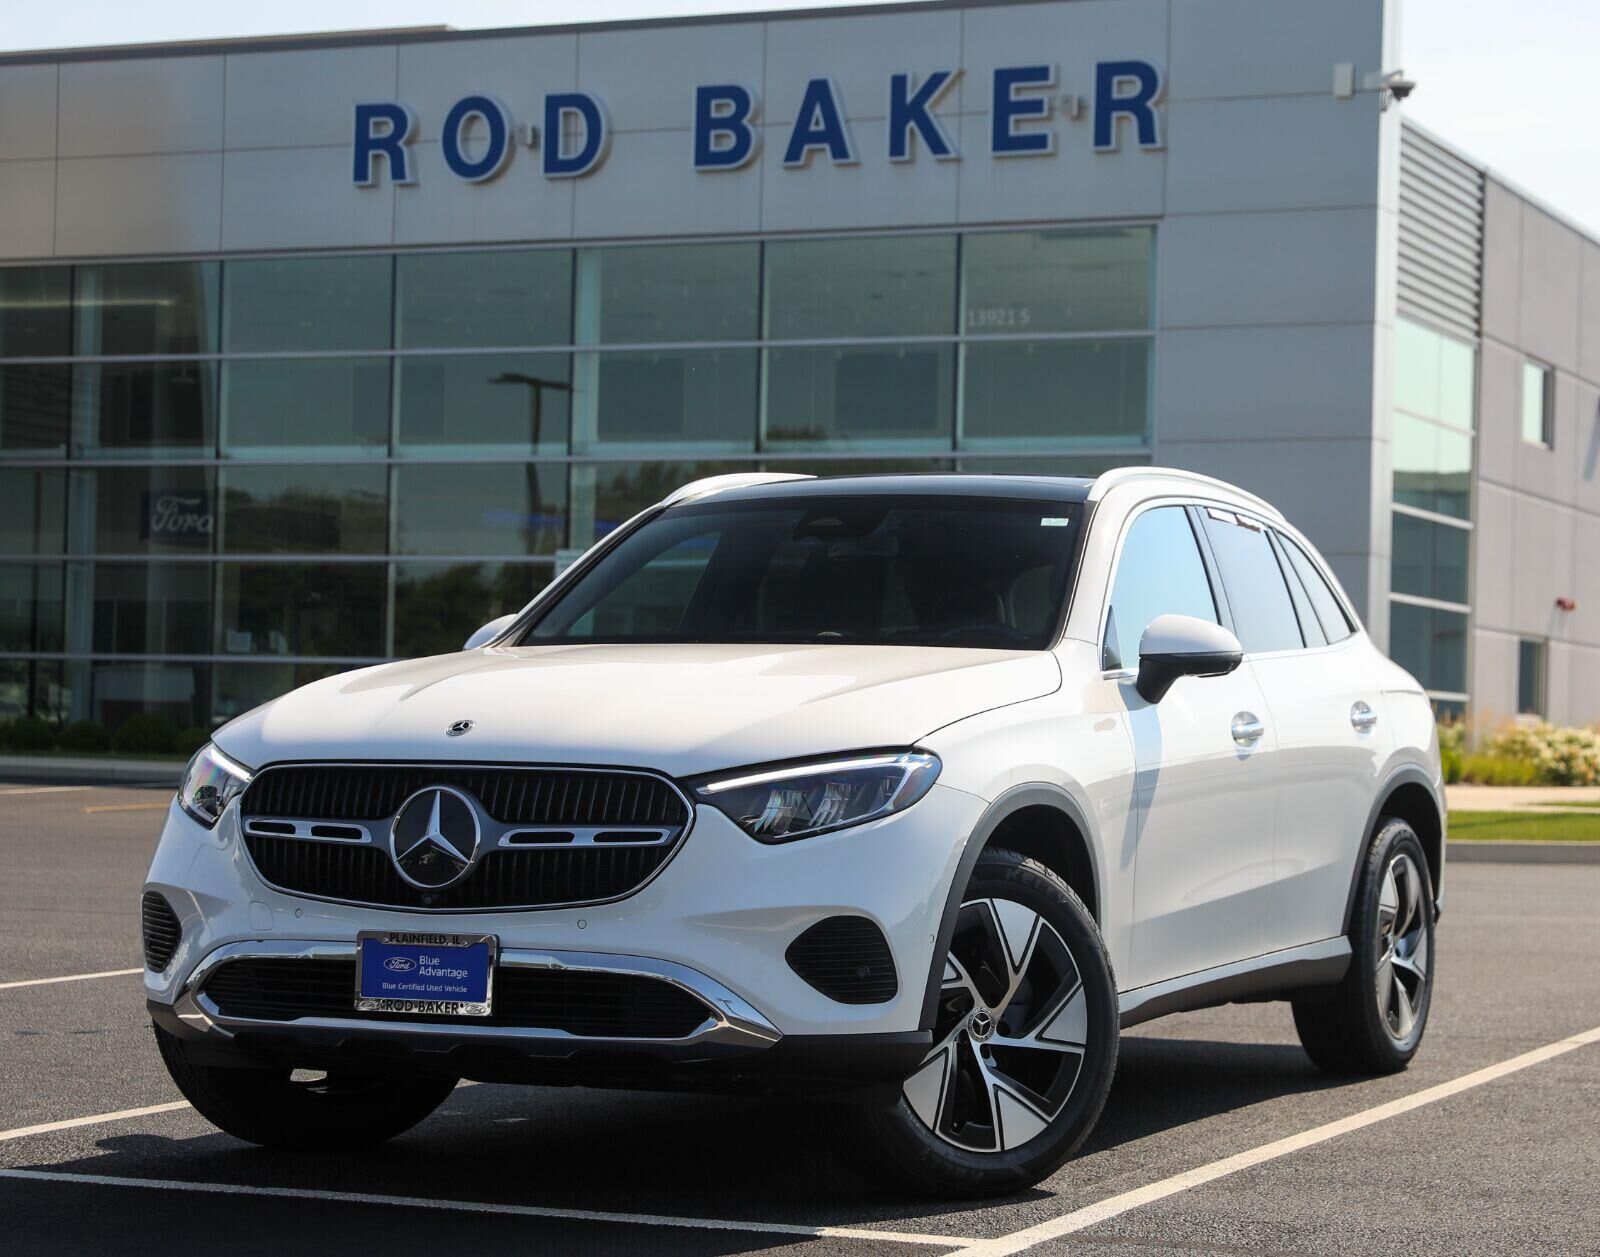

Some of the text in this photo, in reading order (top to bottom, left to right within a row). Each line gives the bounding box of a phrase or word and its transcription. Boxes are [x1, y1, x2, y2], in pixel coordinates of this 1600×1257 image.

[353, 59, 1163, 183] ROD BAKER
[968, 307, 1031, 326] 13921 S
[389, 932, 460, 945] PLAINFIELD, IL
[389, 958, 411, 970] Ford
[419, 955, 440, 966] Blue
[418, 966, 468, 980] Advantage
[382, 982, 468, 993] Blue Certified Used Vehicle
[385, 1001, 414, 1012] ROD
[416, 1001, 460, 1015] BAKER
